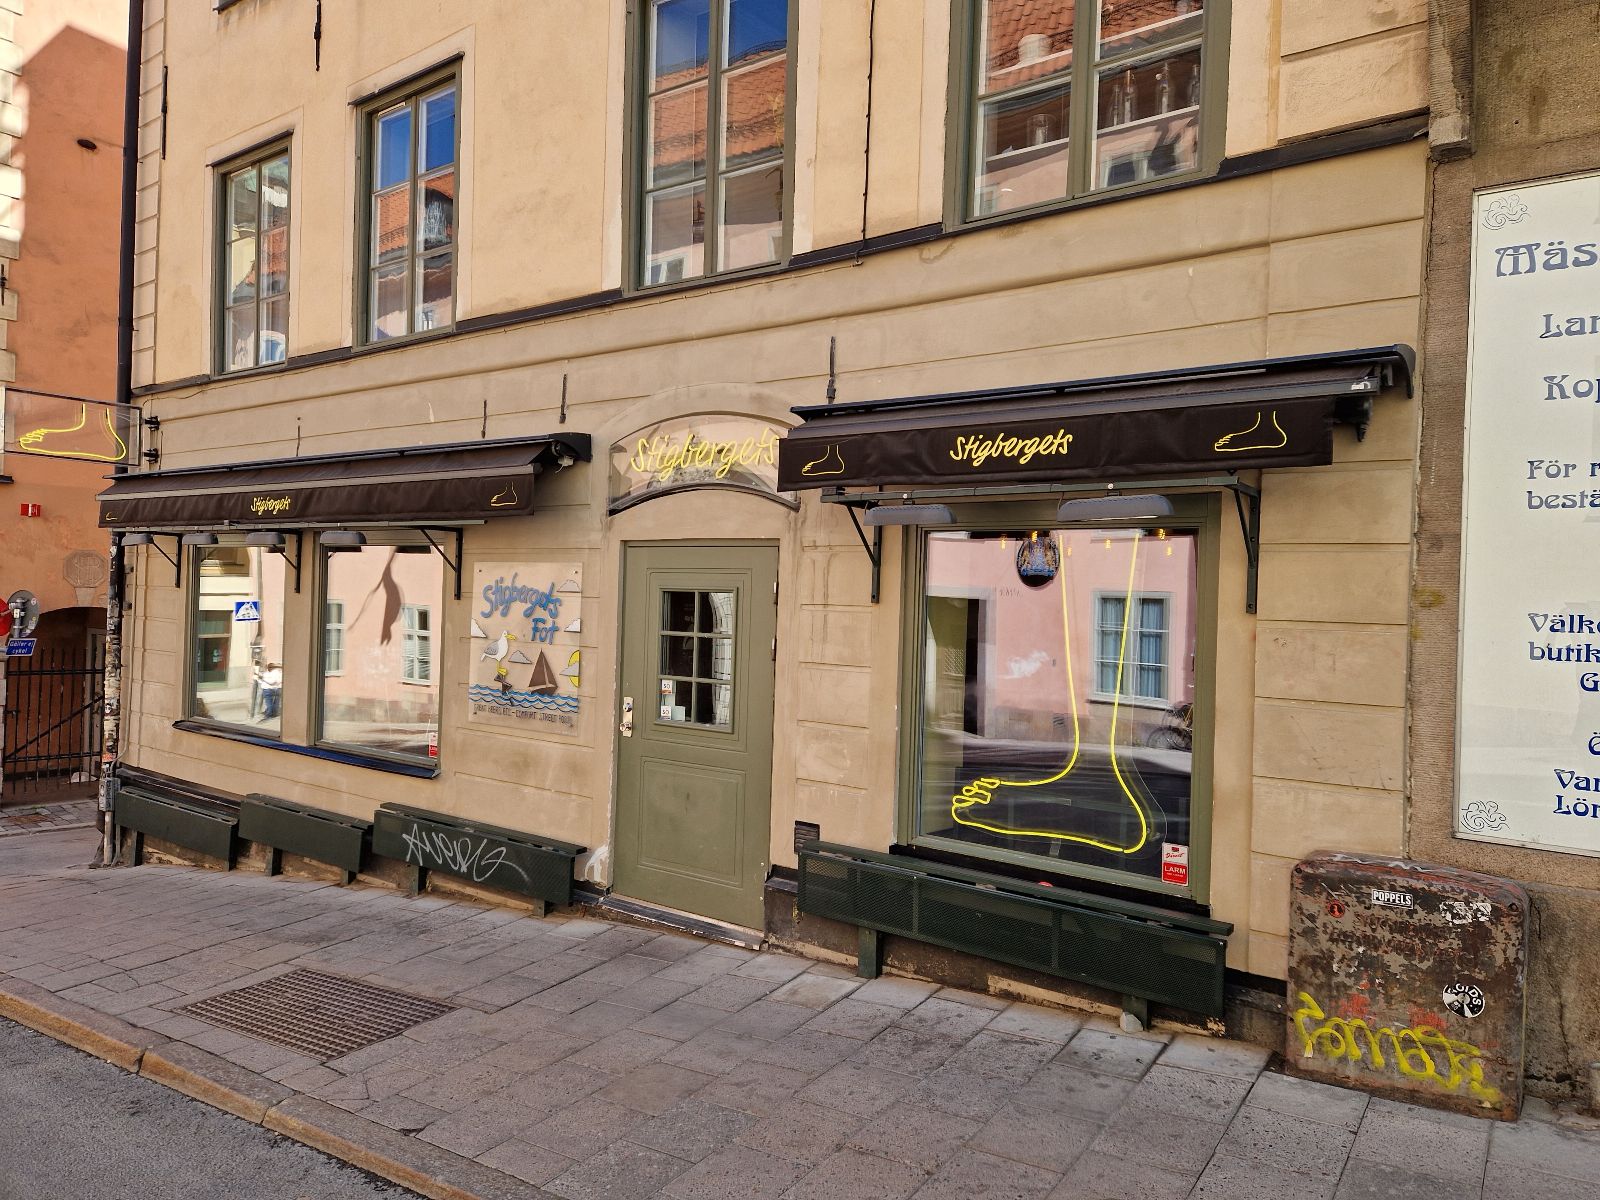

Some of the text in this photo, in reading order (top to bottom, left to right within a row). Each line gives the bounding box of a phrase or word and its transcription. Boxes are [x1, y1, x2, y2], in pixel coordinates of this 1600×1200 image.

[1543, 374, 1600, 403] Ko
[630, 427, 780, 481] Stigbergets
[949, 428, 1074, 467] Stigbergets
[1526, 459, 1577, 479] För
[250, 495, 291, 516] Stigbergets
[1526, 489, 1600, 510] bestä
[480, 571, 562, 619] Stigbergets
[1527, 612, 1600, 634] Välk
[1164, 865, 1186, 875] LARM
[1373, 890, 1412, 906] POPPELS
